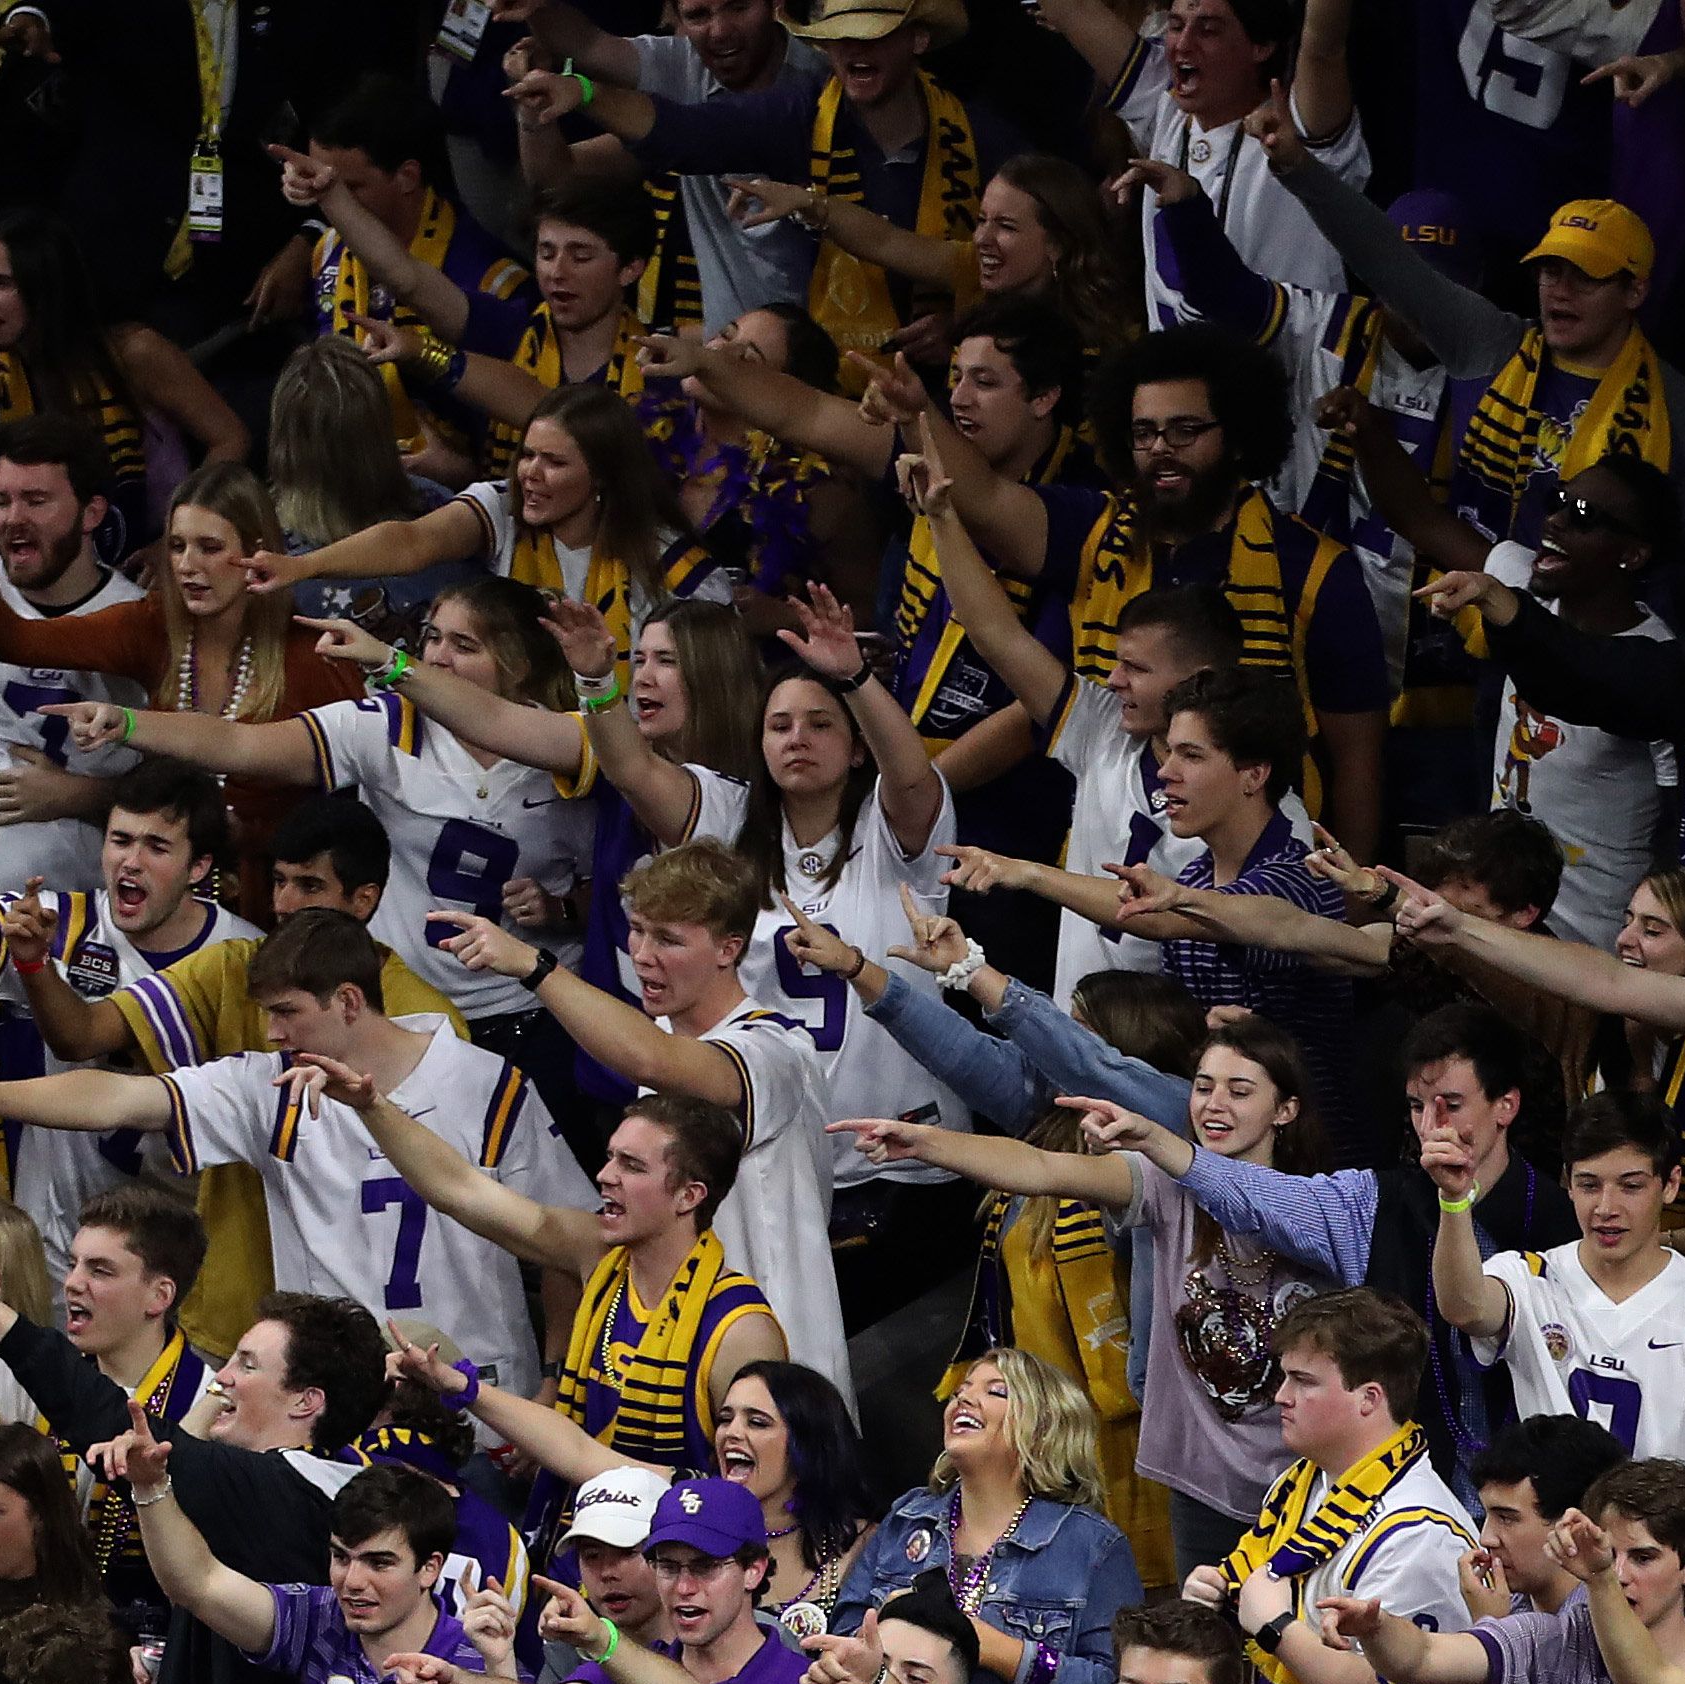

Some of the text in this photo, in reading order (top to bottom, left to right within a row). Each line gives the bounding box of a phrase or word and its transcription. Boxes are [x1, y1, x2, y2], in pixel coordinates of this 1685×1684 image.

[1560, 214, 1599, 233] LSU
[1402, 224, 1453, 243] LSU
[1394, 394, 1430, 412] LSU
[30, 667, 63, 681] LSU
[802, 900, 829, 916] SU
[80, 955, 111, 971] BCS
[361, 1179, 426, 1308] 7
[1589, 1355, 1624, 1371] LSU
